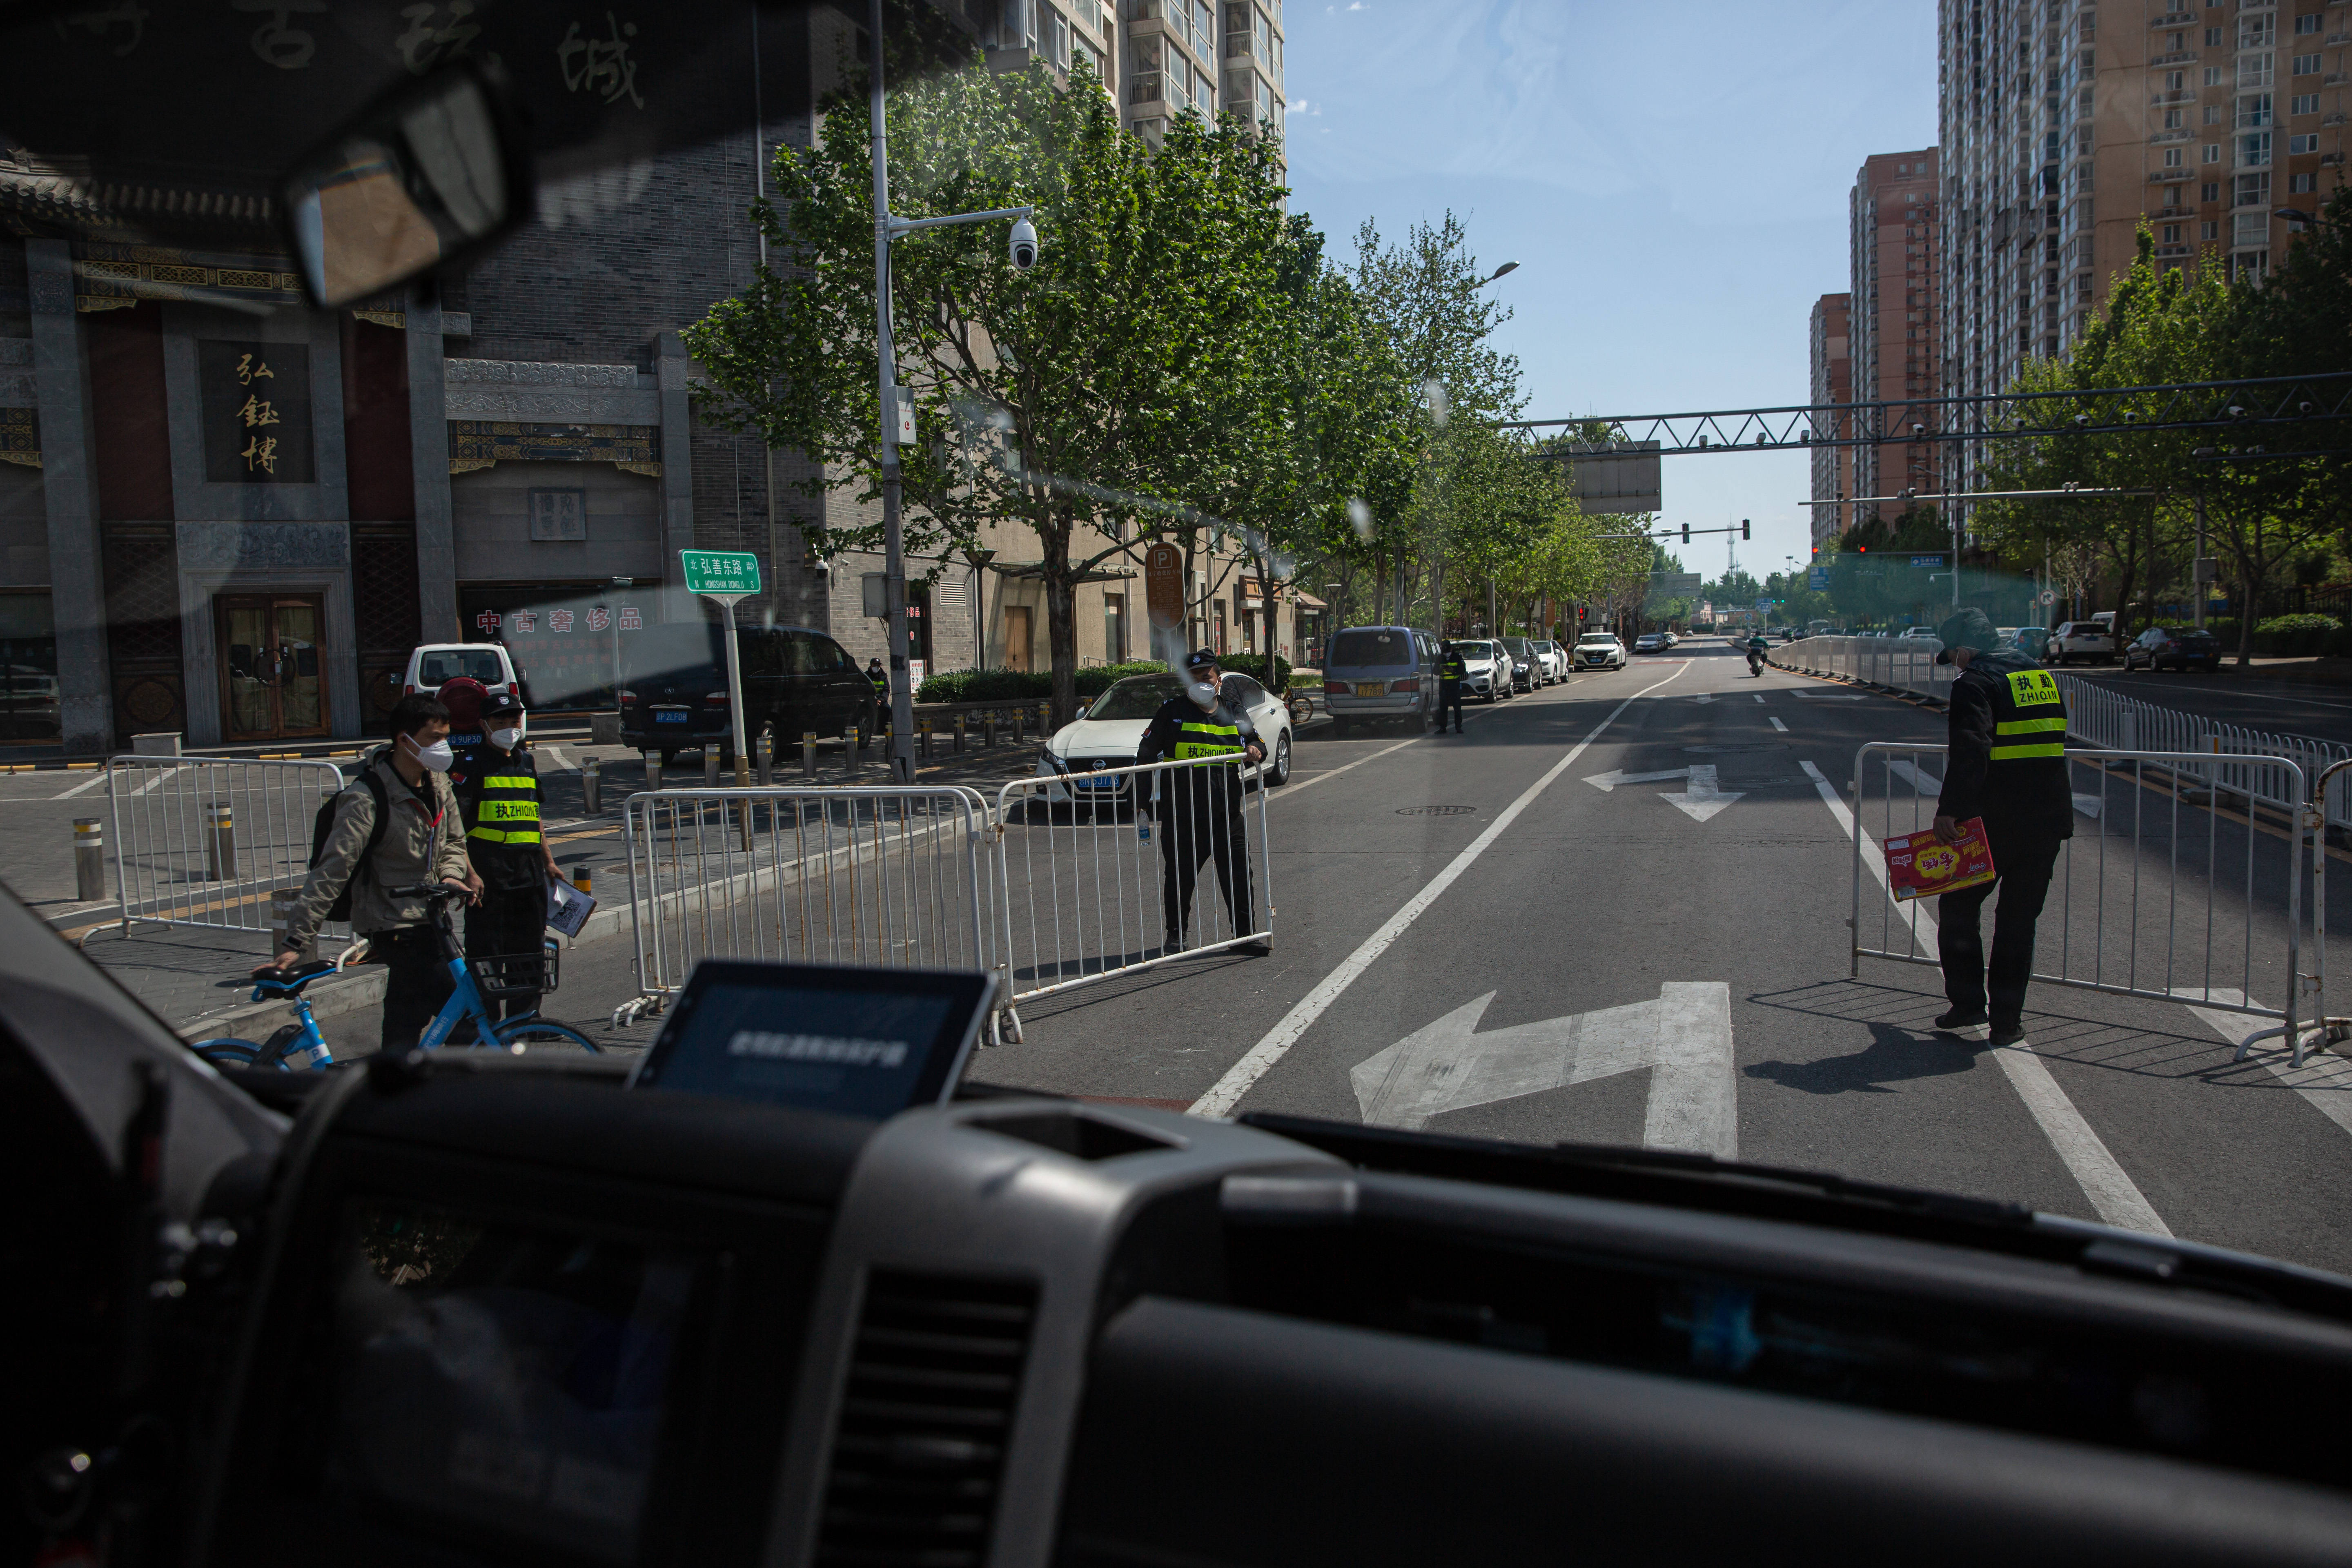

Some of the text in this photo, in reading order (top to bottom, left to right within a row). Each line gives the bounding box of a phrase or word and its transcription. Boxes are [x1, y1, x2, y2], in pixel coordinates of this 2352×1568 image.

[236, 353, 280, 474] 弘钰博
[690, 558, 753, 575] 北 弘善东路 南
[1157, 552, 1167, 566] P
[695, 580, 754, 589] N HONGSHAN DONGLU S
[477, 607, 642, 634] 中古奢侈品
[2017, 673, 2053, 691] 执勤
[2019, 690, 2057, 703] ZHIQIN
[1188, 745, 1199, 758] 执
[495, 803, 510, 819] 执
[510, 806, 535, 817] ZHIQIN
